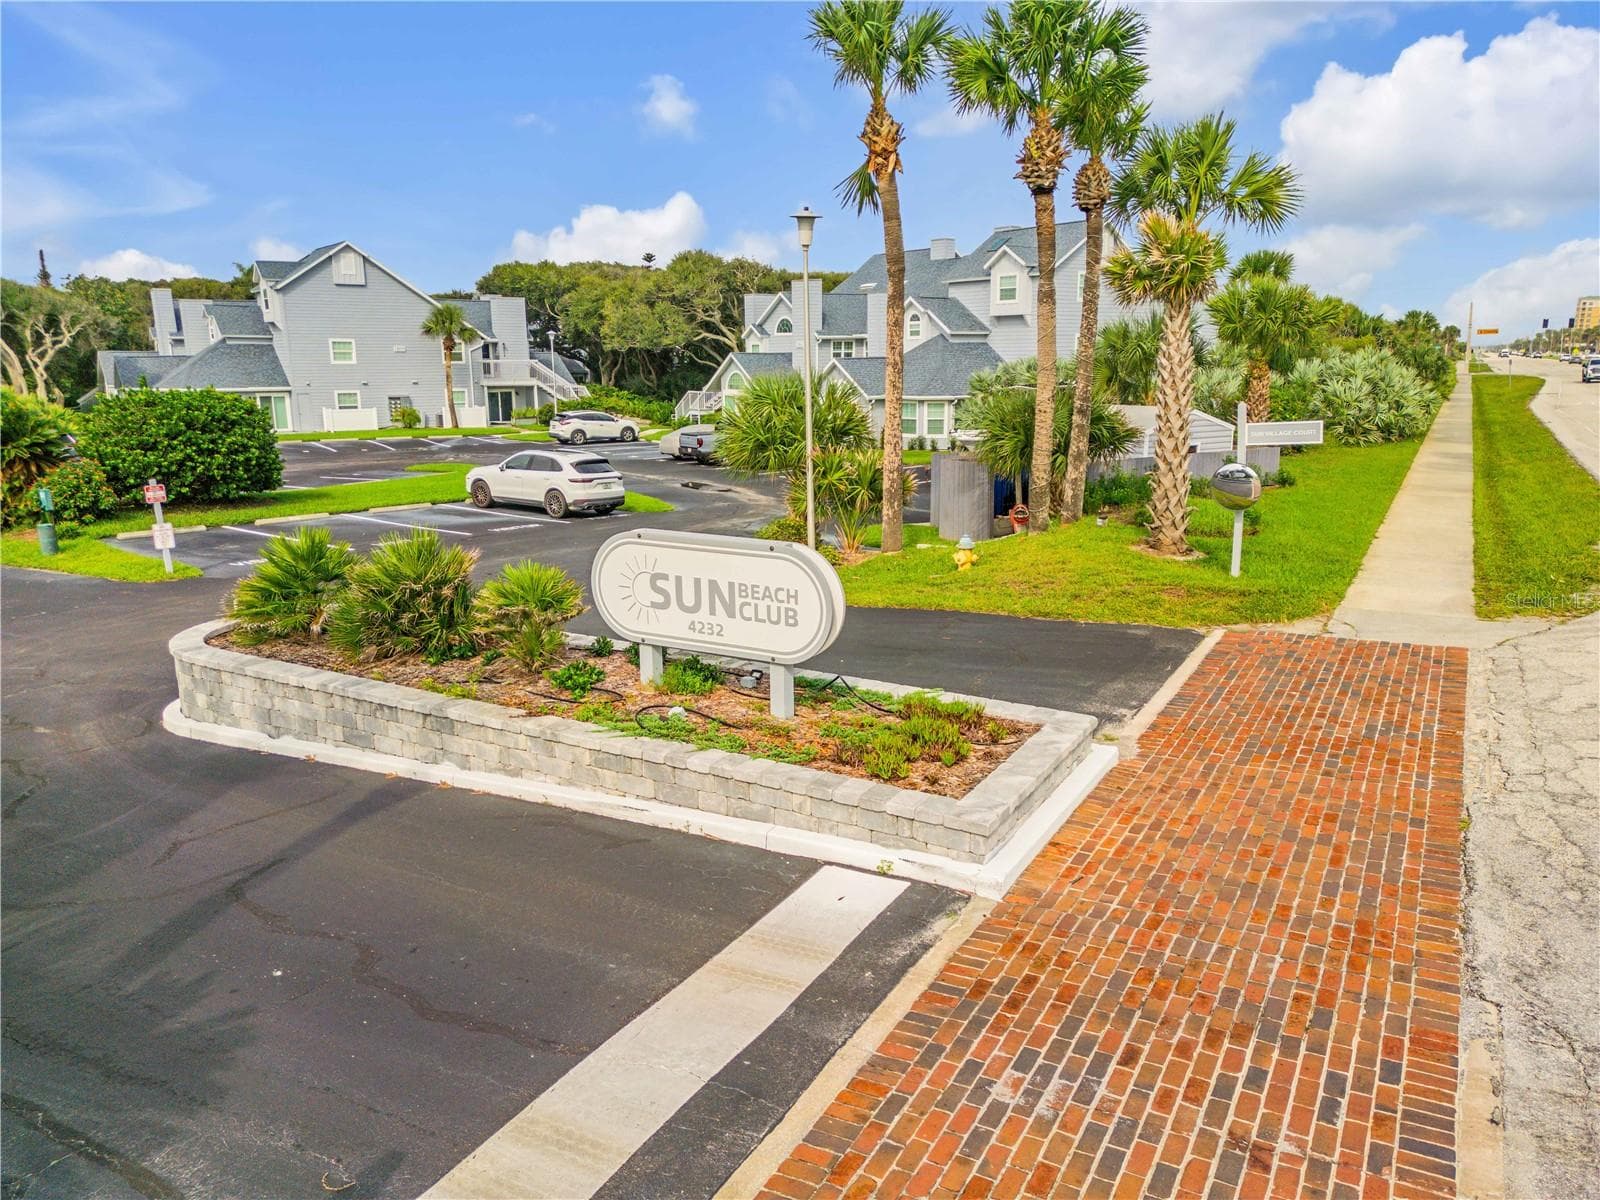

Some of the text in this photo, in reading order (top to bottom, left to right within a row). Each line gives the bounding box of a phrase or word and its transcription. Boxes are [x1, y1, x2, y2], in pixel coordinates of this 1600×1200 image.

[650, 572, 799, 619] SUN BEACH
[739, 602, 799, 628] CLUB
[688, 620, 725, 637] 4232
